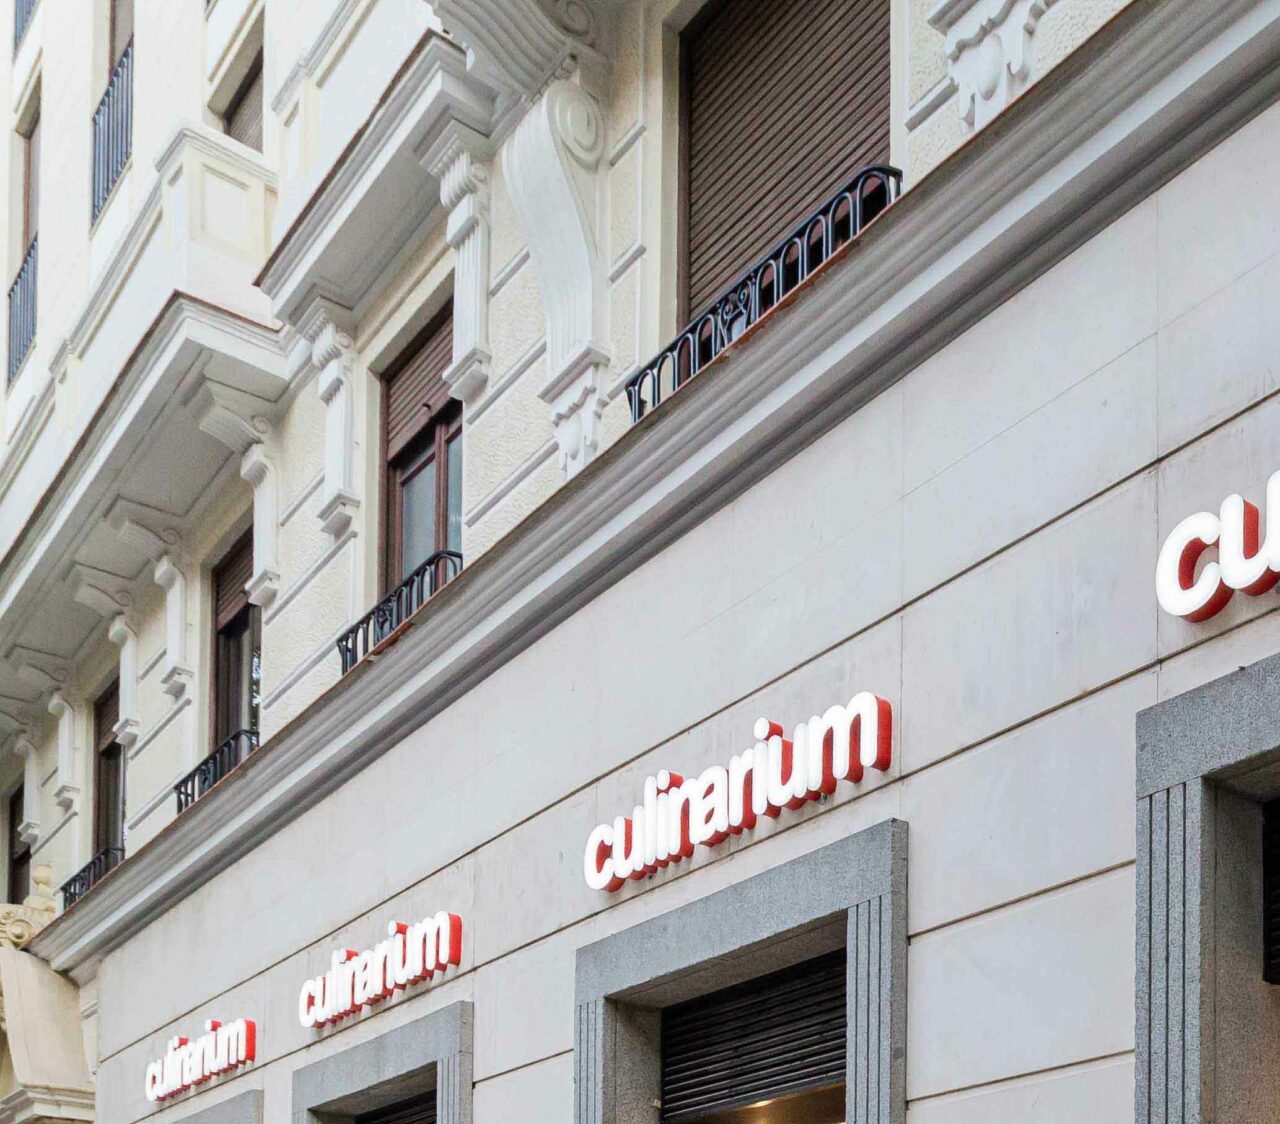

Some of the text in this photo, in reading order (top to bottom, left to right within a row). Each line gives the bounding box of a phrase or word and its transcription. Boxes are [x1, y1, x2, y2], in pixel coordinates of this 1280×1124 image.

[584, 691, 893, 893] culinarium
[299, 911, 463, 1029] culinarium
[146, 1018, 257, 1101] culinarium
